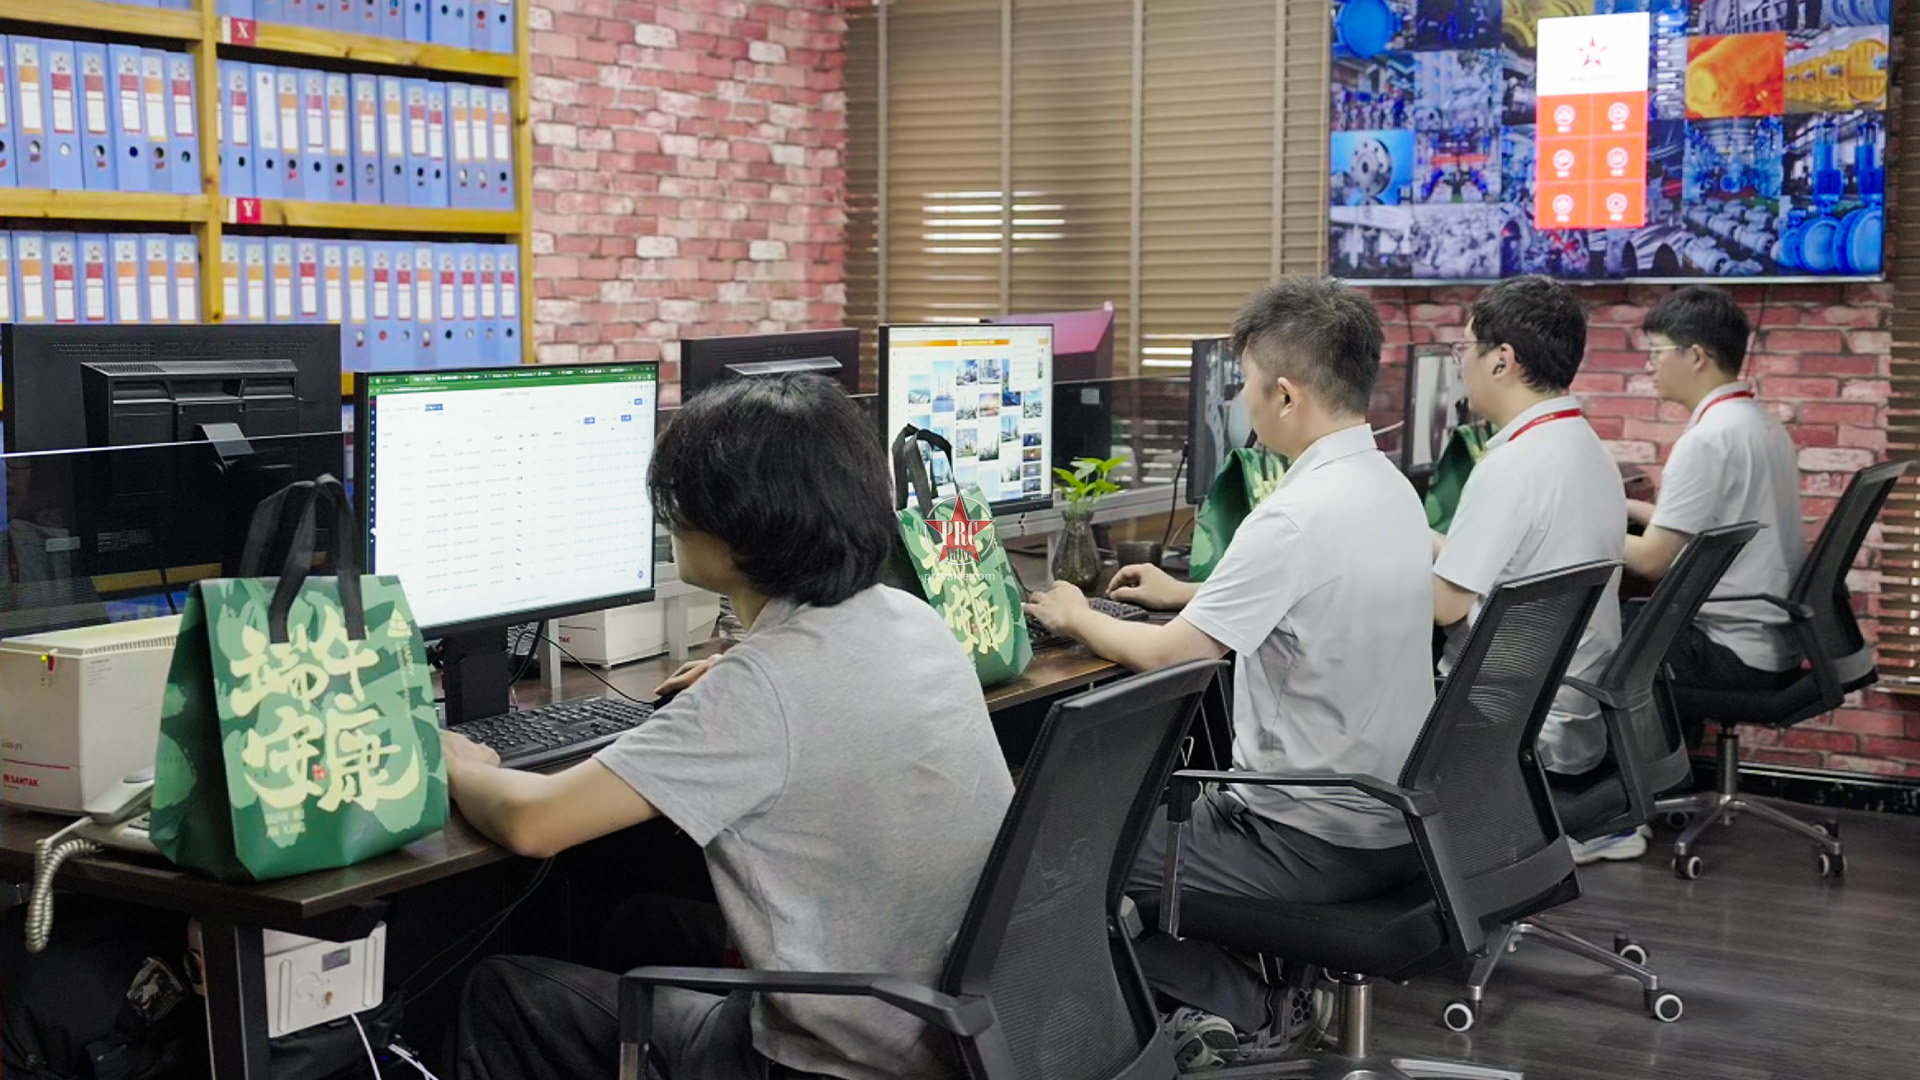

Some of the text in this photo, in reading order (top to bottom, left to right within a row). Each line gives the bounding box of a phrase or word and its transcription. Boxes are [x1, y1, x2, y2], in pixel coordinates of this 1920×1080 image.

[237, 20, 249, 39] X
[243, 199, 255, 217] Y
[230, 605, 380, 718] 端午
[242, 692, 421, 812] 安康
